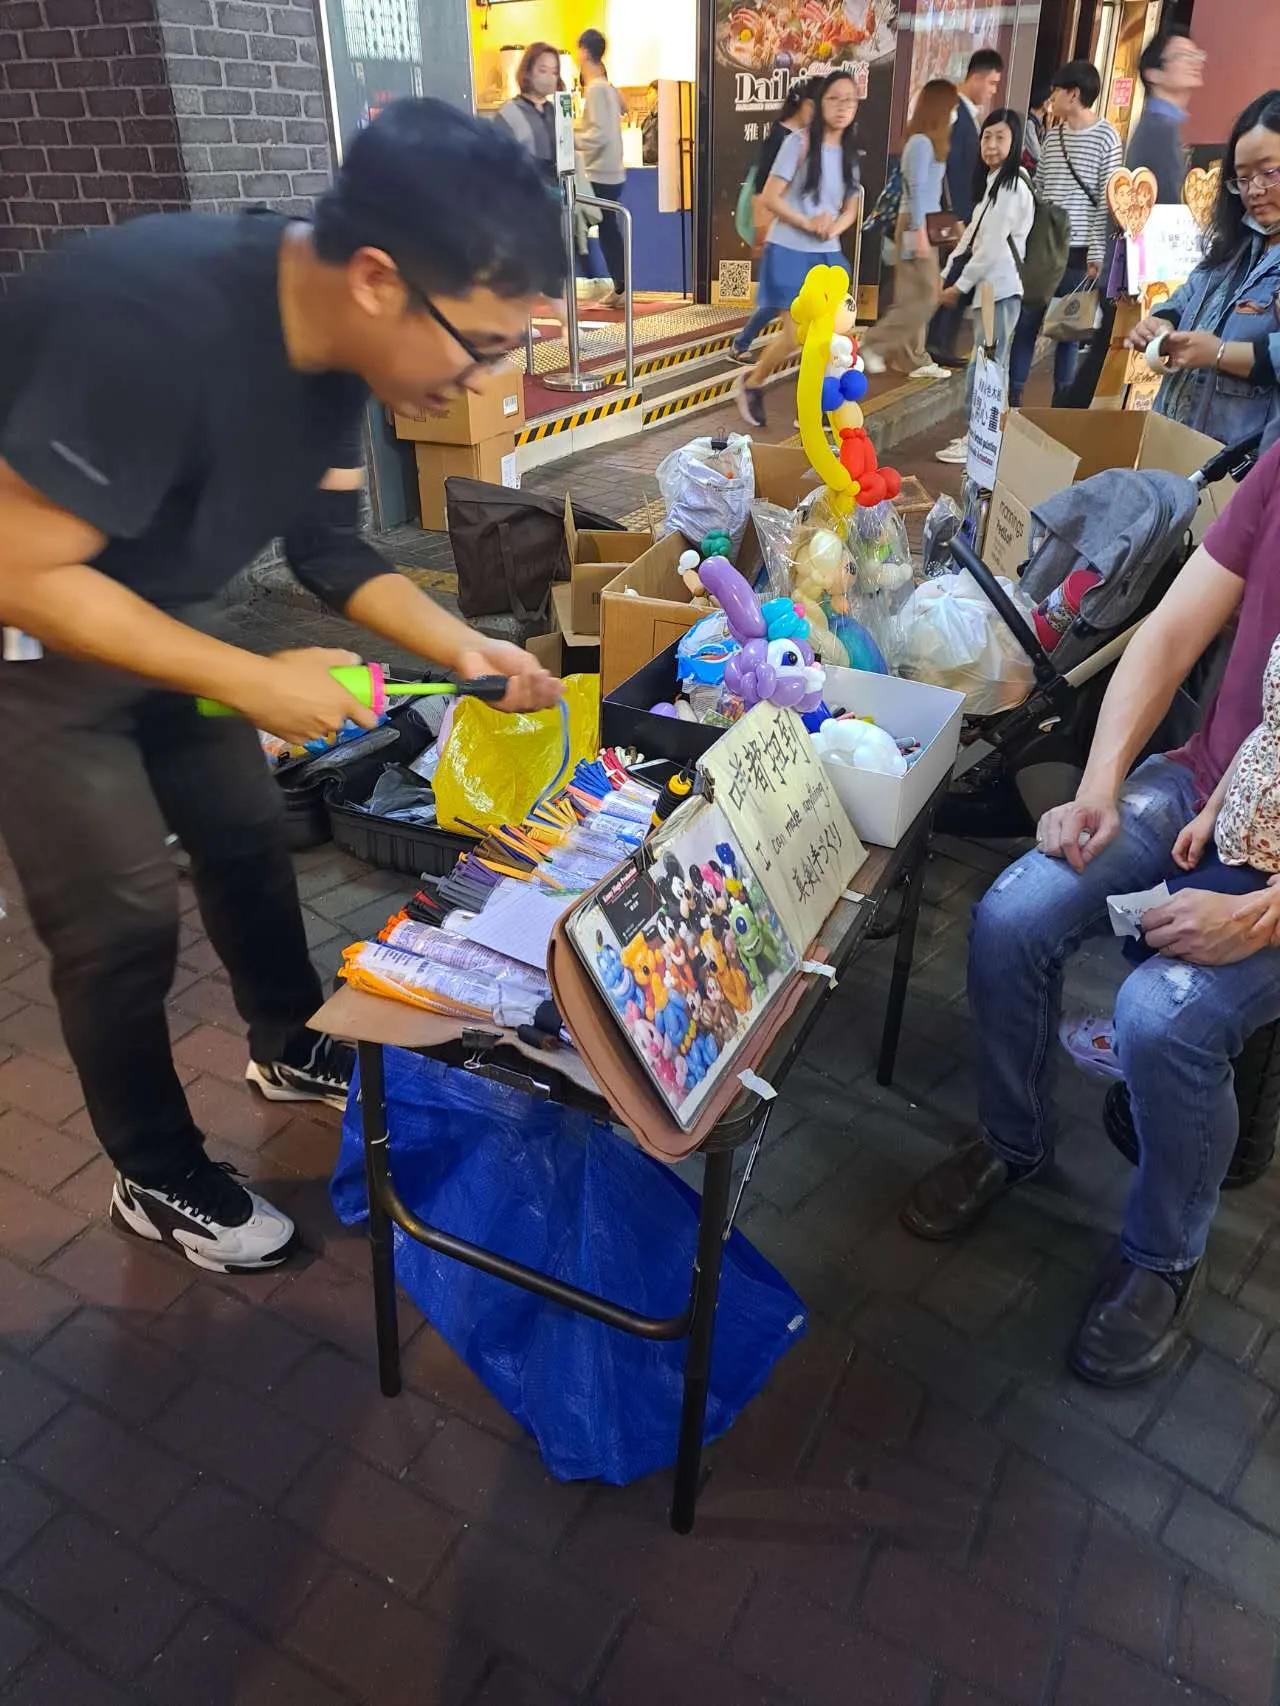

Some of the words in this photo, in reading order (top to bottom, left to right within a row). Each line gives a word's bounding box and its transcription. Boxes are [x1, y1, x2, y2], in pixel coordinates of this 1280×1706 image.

[755, 839, 771, 872] I
[771, 836, 787, 855] can
[785, 803, 803, 838] make
